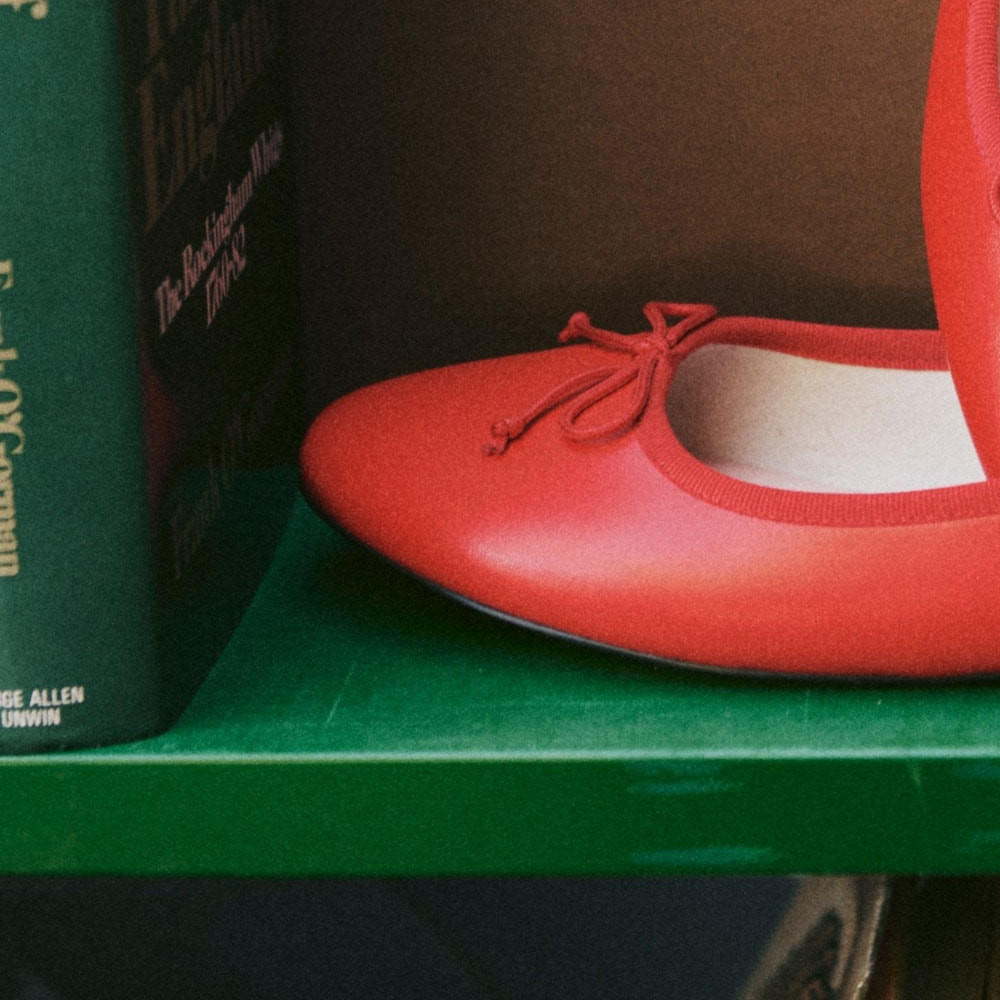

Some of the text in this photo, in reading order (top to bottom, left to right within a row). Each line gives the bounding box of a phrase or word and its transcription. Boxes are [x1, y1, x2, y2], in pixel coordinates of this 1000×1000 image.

[155, 276, 182, 337] The
[182, 168, 253, 300] Rockingham
[205, 224, 246, 329] 1760-82
[0, 685, 84, 708] GE ALLEN
[1, 707, 61, 728] UNWIN
